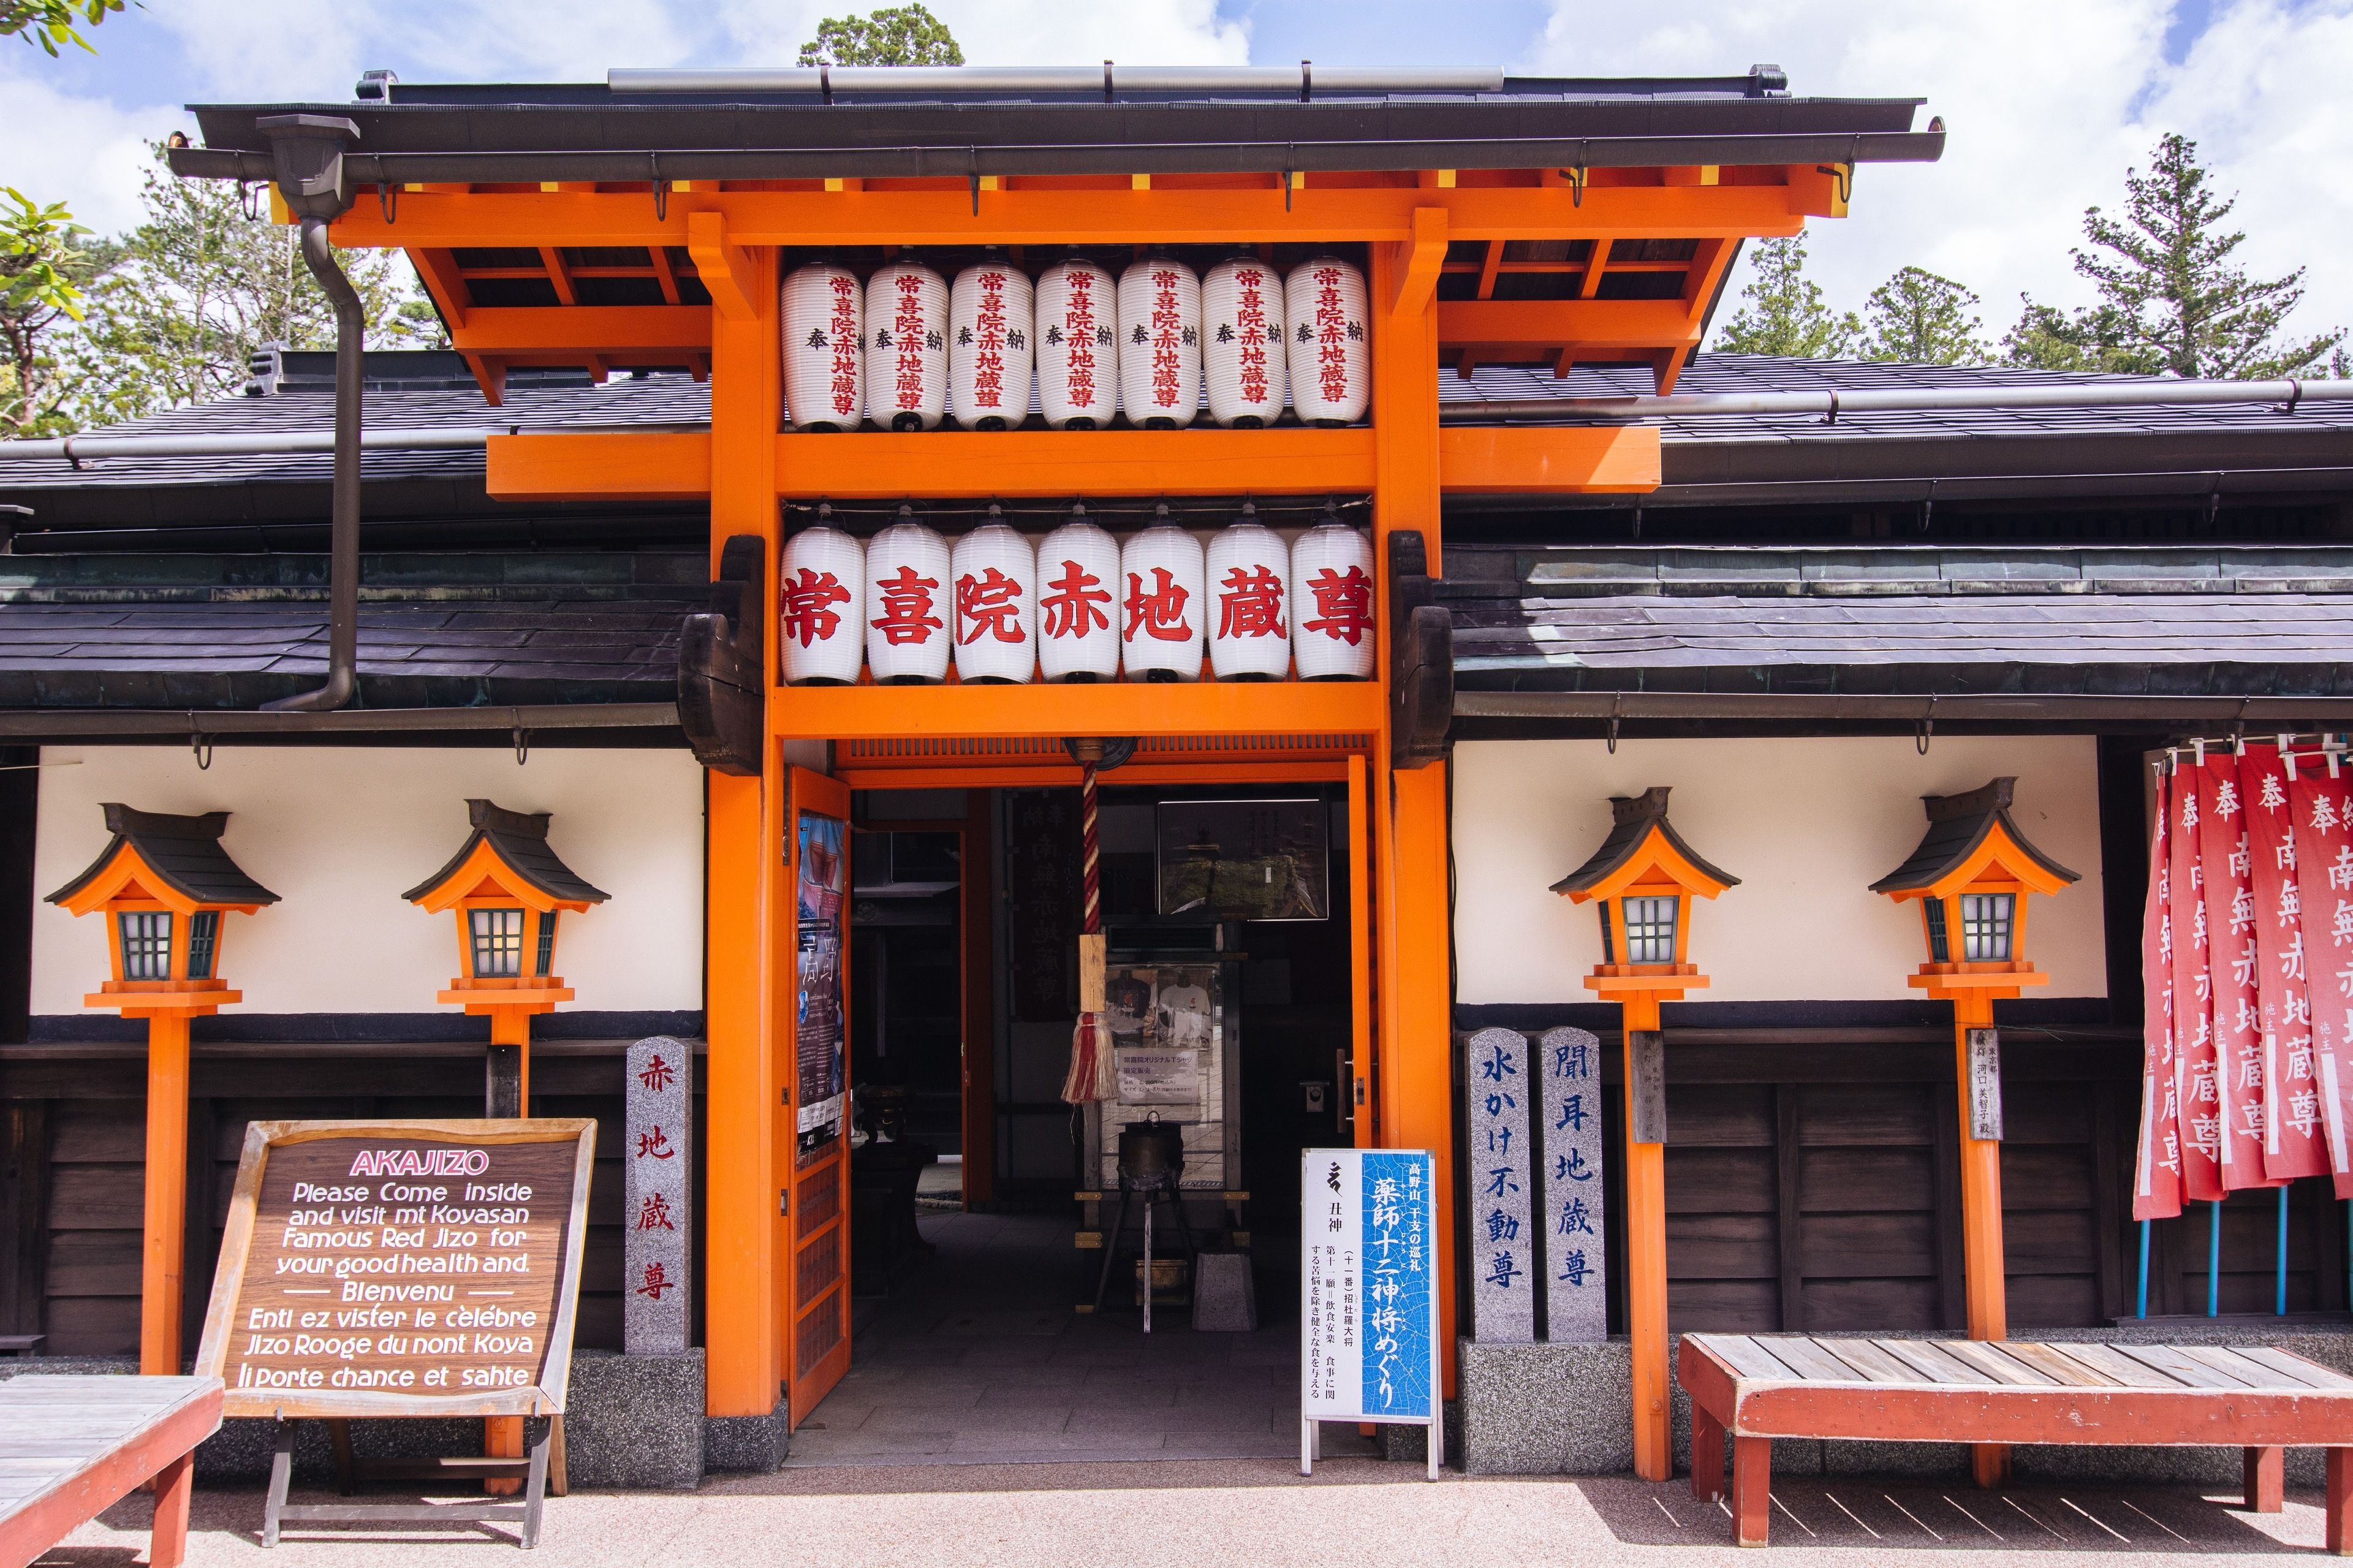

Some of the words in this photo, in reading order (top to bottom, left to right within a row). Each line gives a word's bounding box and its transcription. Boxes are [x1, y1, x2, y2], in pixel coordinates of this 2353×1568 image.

[805, 328, 829, 350] 奉
[875, 328, 895, 350] 奉
[894, 275, 925, 410] 常喜院赤地蔵尊
[925, 330, 943, 352] 納
[957, 326, 974, 347] 奉
[974, 273, 1007, 408] 常喜院赤地蔵尊
[1006, 328, 1025, 351] 納
[1045, 324, 1064, 347] 奉
[1066, 271, 1096, 409] 常喜院赤地蔵尊
[1096, 325, 1113, 347] 納
[1130, 324, 1150, 346] 奉
[1152, 270, 1181, 407] 常喜院赤地蔵尊
[1181, 325, 1197, 347] 納
[1215, 324, 1236, 344] 奉
[1235, 270, 1268, 404] 常喜院赤地蔵尊
[1267, 323, 1282, 344] 納
[1296, 323, 1315, 344] 奉
[1313, 267, 1348, 403] 常喜院赤地蔵尊
[1347, 320, 1364, 342] 納
[828, 276, 857, 416] 常喜院赤地蔵尊
[2214, 780, 2241, 822] 奉
[2259, 773, 2287, 815] 奉
[2180, 792, 2199, 835] 奉
[2309, 794, 2340, 836] 奉
[349, 1149, 489, 1176] AKAJIZO
[1483, 1045, 1522, 1288] 水かけ不動尊
[1556, 1045, 1594, 1287] 聞耳地蔵尊
[637, 1055, 675, 1300] 赤地蔵尊
[1409, 1163, 1420, 1201] 高野山
[292, 1182, 369, 1203] Please
[380, 1182, 447, 1202] Come
[464, 1183, 532, 1202] inside
[289, 1206, 334, 1225] and
[341, 1205, 386, 1225] visit
[395, 1205, 426, 1224] mt
[430, 1205, 529, 1225] Koyasan
[1328, 1202, 1342, 1232] 丑神
[282, 1227, 373, 1248] Famous
[381, 1227, 424, 1248] Red
[433, 1228, 477, 1248] Jizo
[490, 1227, 527, 1247] for
[275, 1256, 333, 1275] your
[335, 1254, 399, 1279] good
[401, 1253, 479, 1273] health
[482, 1253, 529, 1273] and.
[1371, 1177, 1401, 1408] 薬師十二神将めぐり
[300, 1312, 331, 1328] ez
[414, 1307, 436, 1328] le
[1311, 1245, 1320, 1399] する苦悩を除き健全な食を与える
[244, 1335, 290, 1356] Jizo
[294, 1334, 371, 1360] Rooge
[377, 1333, 407, 1354] du
[412, 1335, 467, 1354] nont
[473, 1333, 533, 1355] Koya
[330, 1365, 416, 1387] chance
[423, 1368, 449, 1387] et
[461, 1365, 529, 1387] sahte
[1325, 1356, 1335, 1399] 食事に関
